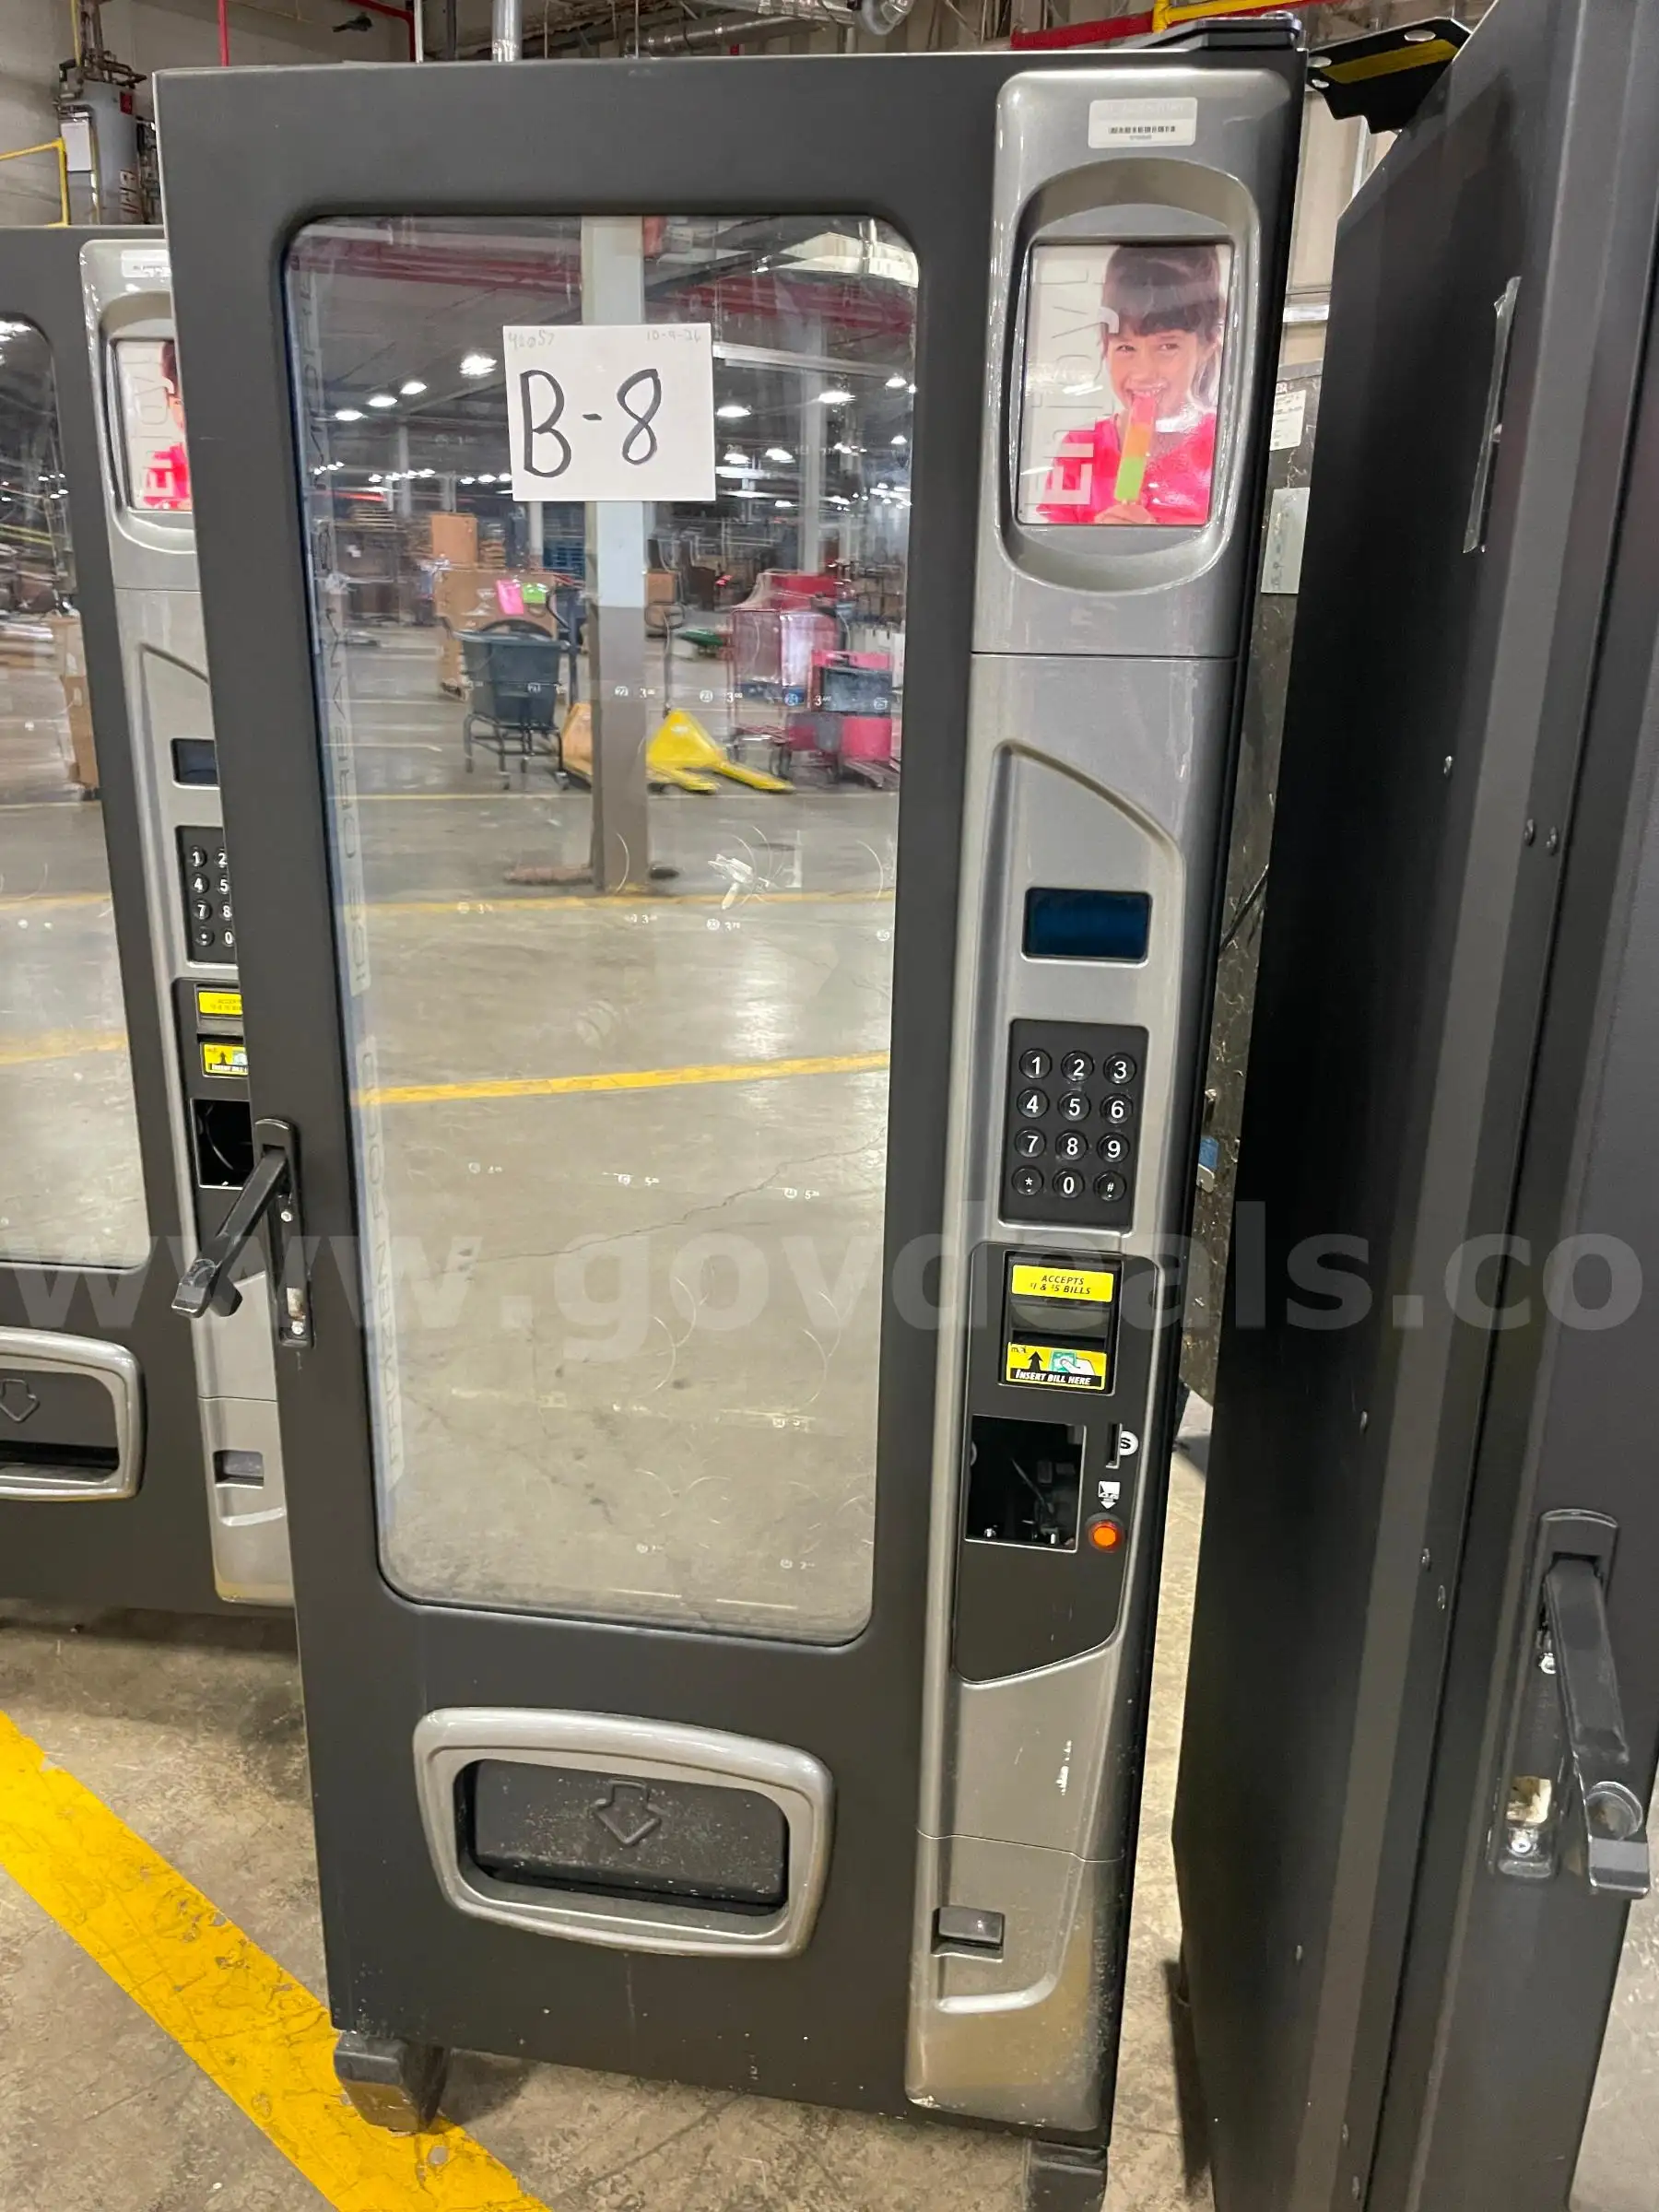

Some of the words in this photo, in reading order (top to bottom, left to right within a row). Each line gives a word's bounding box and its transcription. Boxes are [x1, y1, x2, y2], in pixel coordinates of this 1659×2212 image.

[193, 851, 200, 865] 1
[194, 877, 204, 892] 4
[197, 904, 206, 917] 7
[1031, 1056, 1041, 1076] 1
[1073, 1059, 1085, 1077] 2
[1113, 1061, 1126, 1079] 3
[1026, 1094, 1039, 1113] 4
[1068, 1098, 1081, 1116] 5
[1111, 1100, 1124, 1119] 6
[1027, 1135, 1039, 1153] 7
[1066, 1137, 1078, 1156] 8
[1107, 1140, 1121, 1159] 9
[1063, 1176, 1075, 1194] 0
[1041, 1275, 1085, 1286] ACCEPTS
[1063, 1285, 1091, 1295] BILLS
